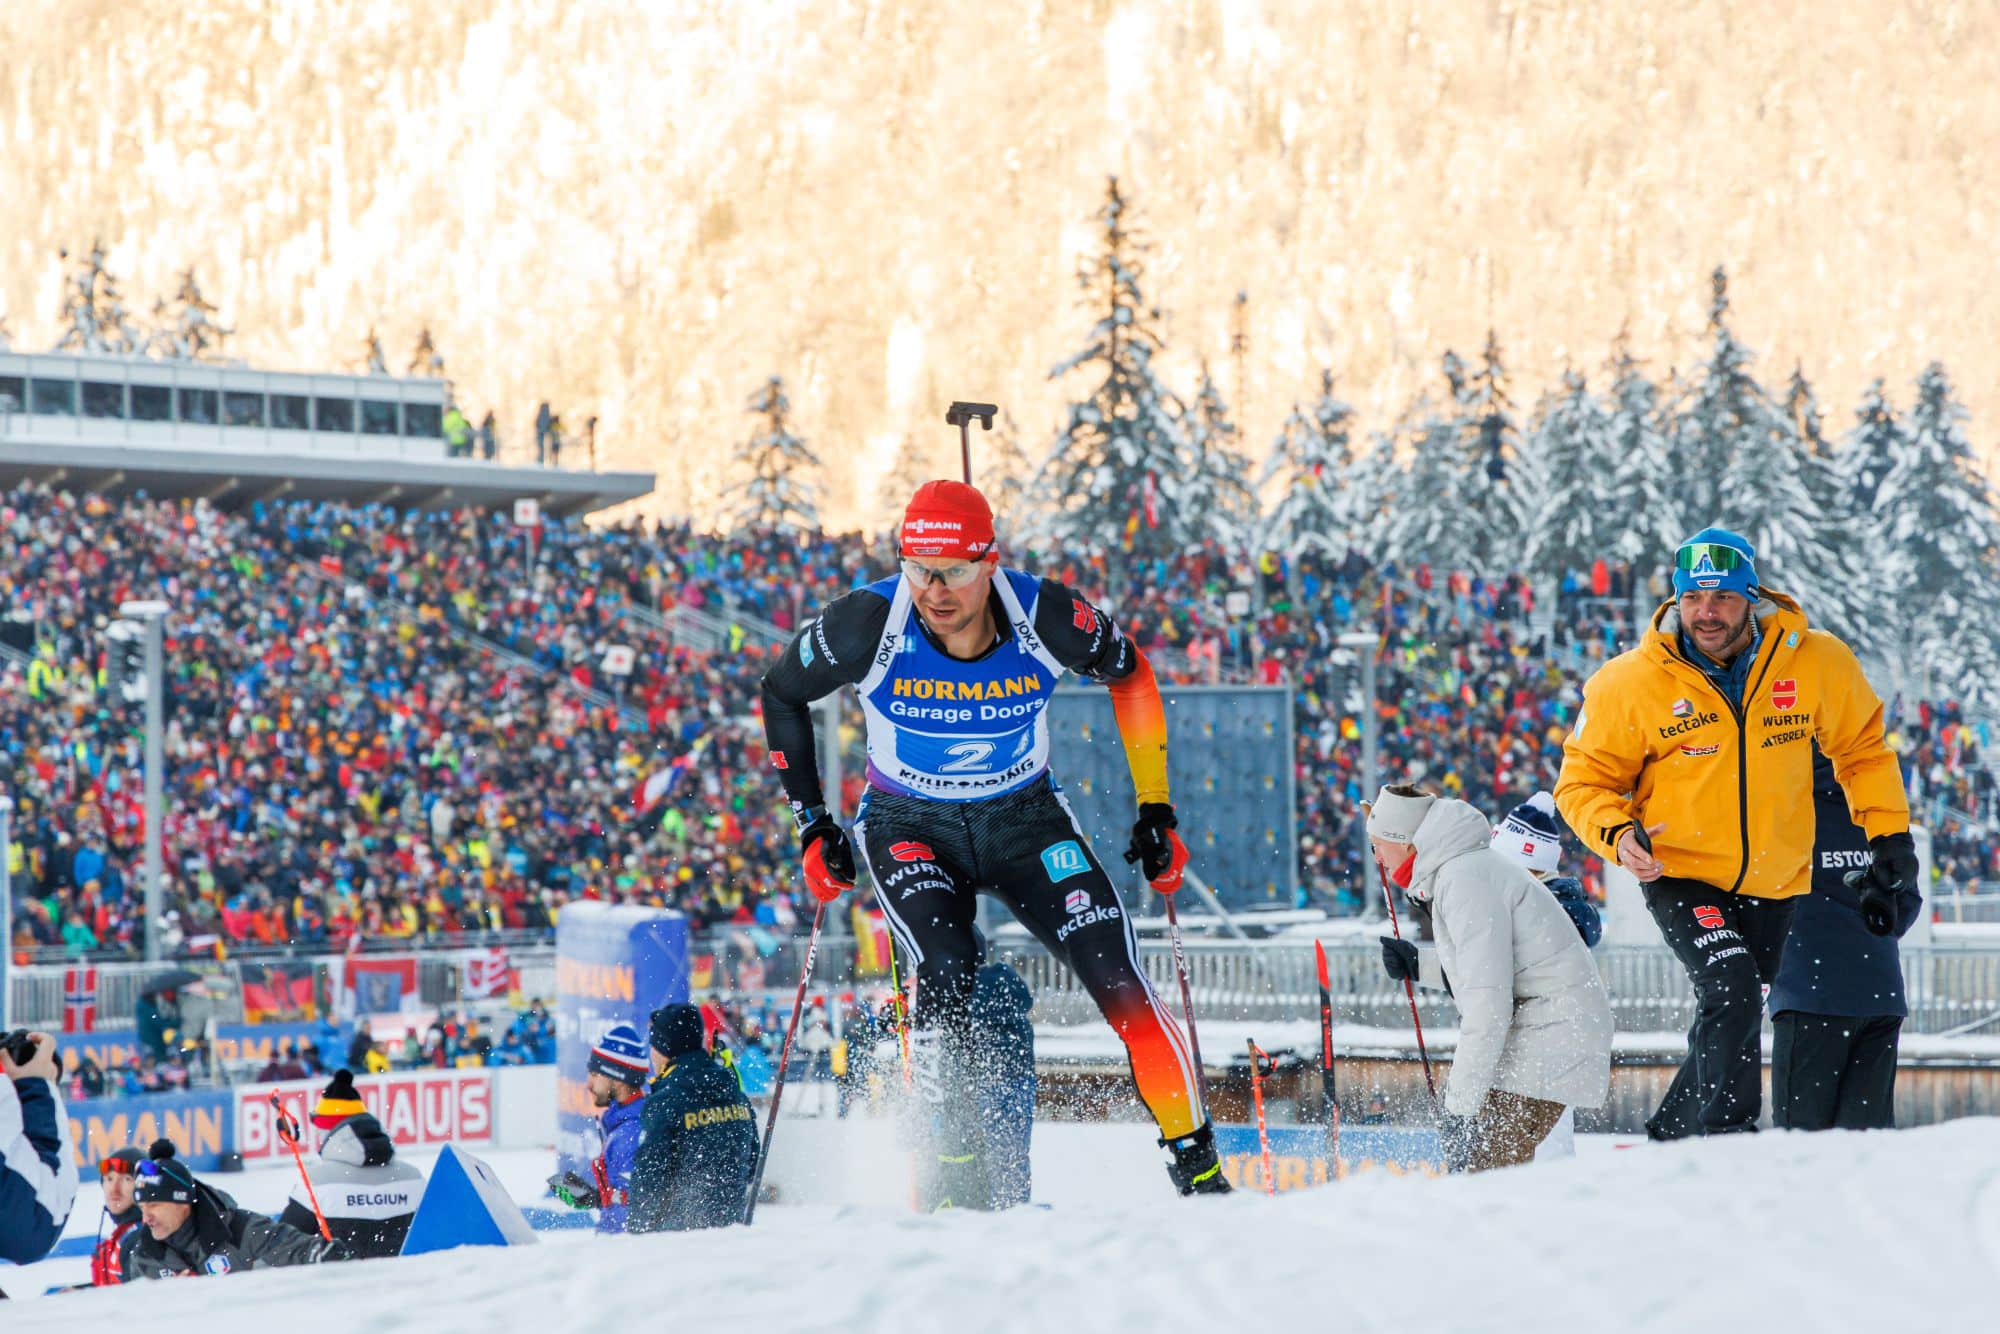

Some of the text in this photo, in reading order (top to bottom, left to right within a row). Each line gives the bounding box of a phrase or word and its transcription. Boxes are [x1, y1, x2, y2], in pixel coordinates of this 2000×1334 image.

[1013, 620, 1041, 652] JOKA
[876, 633, 897, 668] JOKA
[893, 673, 1041, 701] HÖRMANN
[889, 697, 1045, 724] Garage Doors
[1763, 713, 1810, 727] WÜRTH
[1659, 711, 1720, 739] tectake
[938, 740, 997, 774] 2
[1056, 905, 1120, 942] tectake
[346, 1194, 408, 1207] BELGIUM
